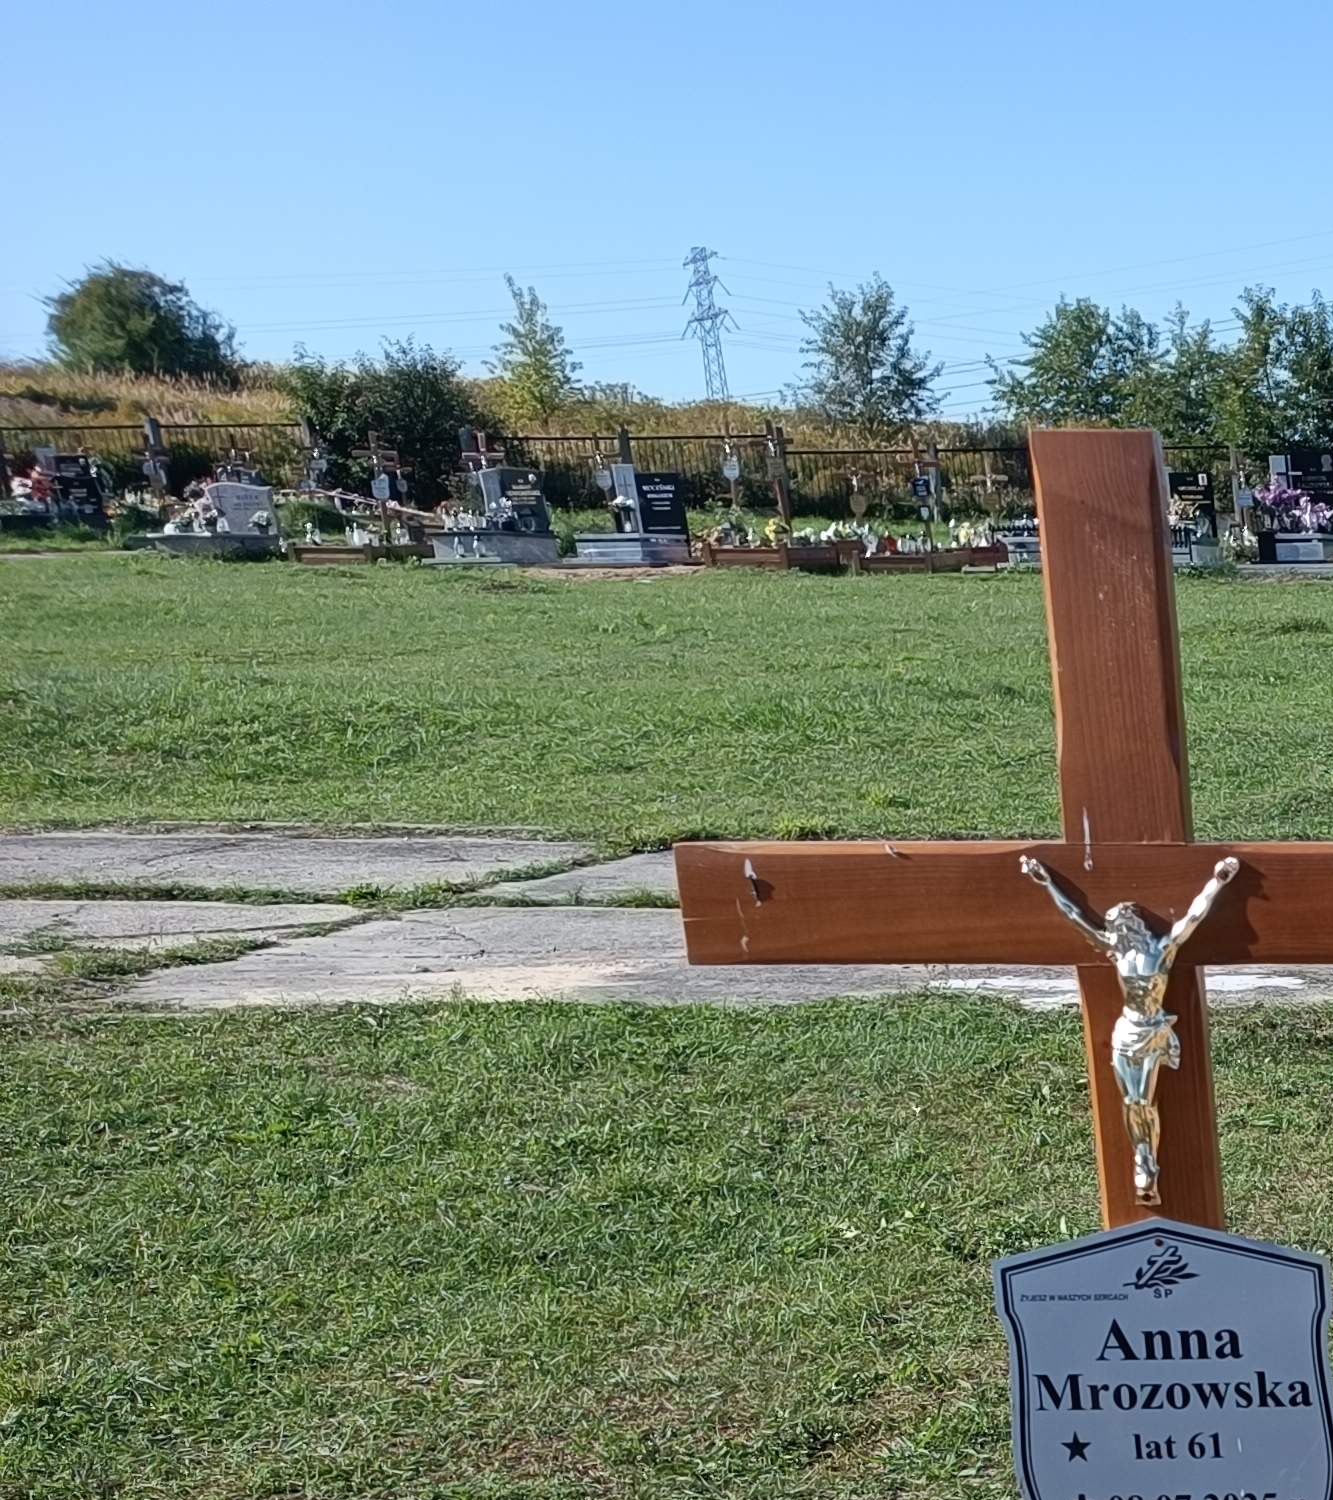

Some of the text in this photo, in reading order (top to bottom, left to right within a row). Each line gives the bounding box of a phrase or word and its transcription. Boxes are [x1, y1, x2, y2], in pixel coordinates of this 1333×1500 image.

[1096, 1318, 1243, 1361] Anna
[1032, 1371, 1313, 1411] Mrozowska
[1133, 1432, 1224, 1460] lat 61
